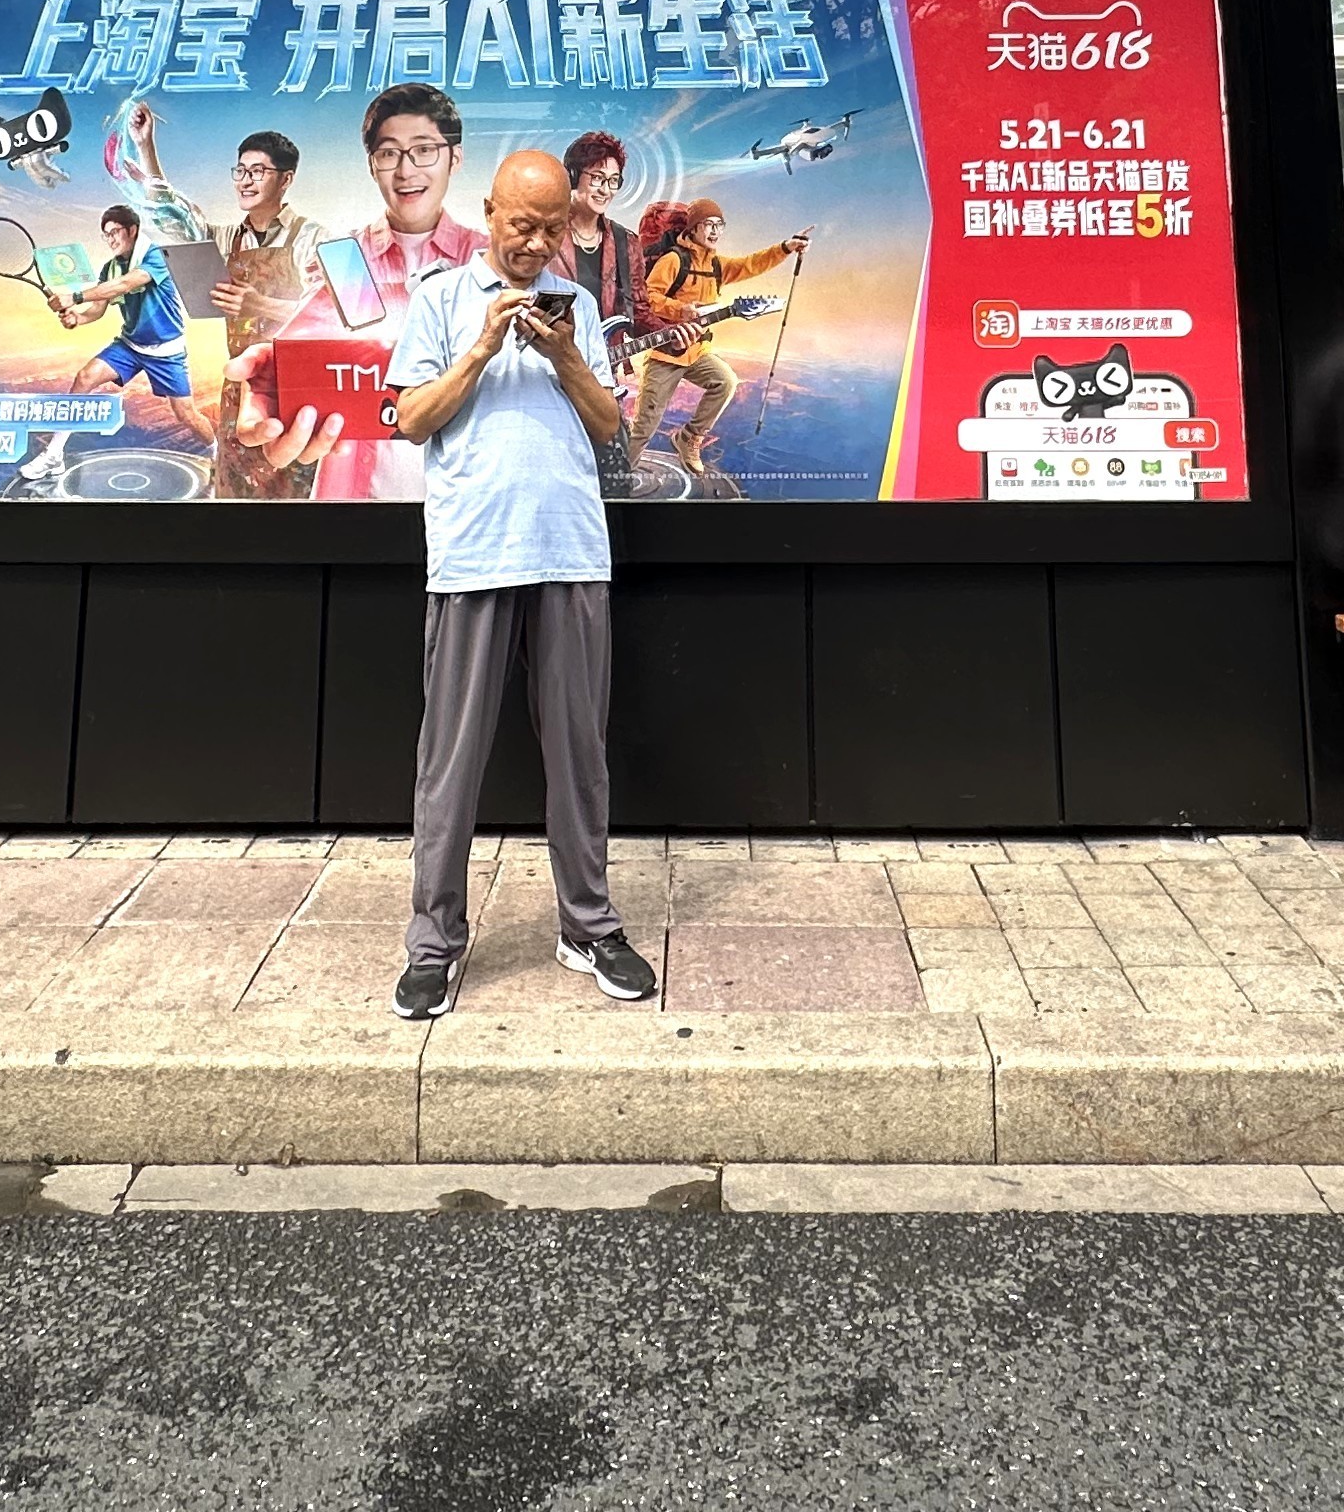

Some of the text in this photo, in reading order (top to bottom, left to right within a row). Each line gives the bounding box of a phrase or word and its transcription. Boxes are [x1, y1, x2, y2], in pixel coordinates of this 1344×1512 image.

[987, 29, 1154, 71] 天猫618
[999, 118, 1146, 150] 5.21-6.21
[961, 159, 1191, 193] 千款AI新品天猫首发
[962, 192, 1194, 239] 国补叠券低至5折
[979, 308, 1016, 339] 淘
[1030, 316, 1174, 331] 上淘宝 天猫618更优惠
[325, 363, 389, 392] TM
[1042, 426, 1117, 445] 天猫618
